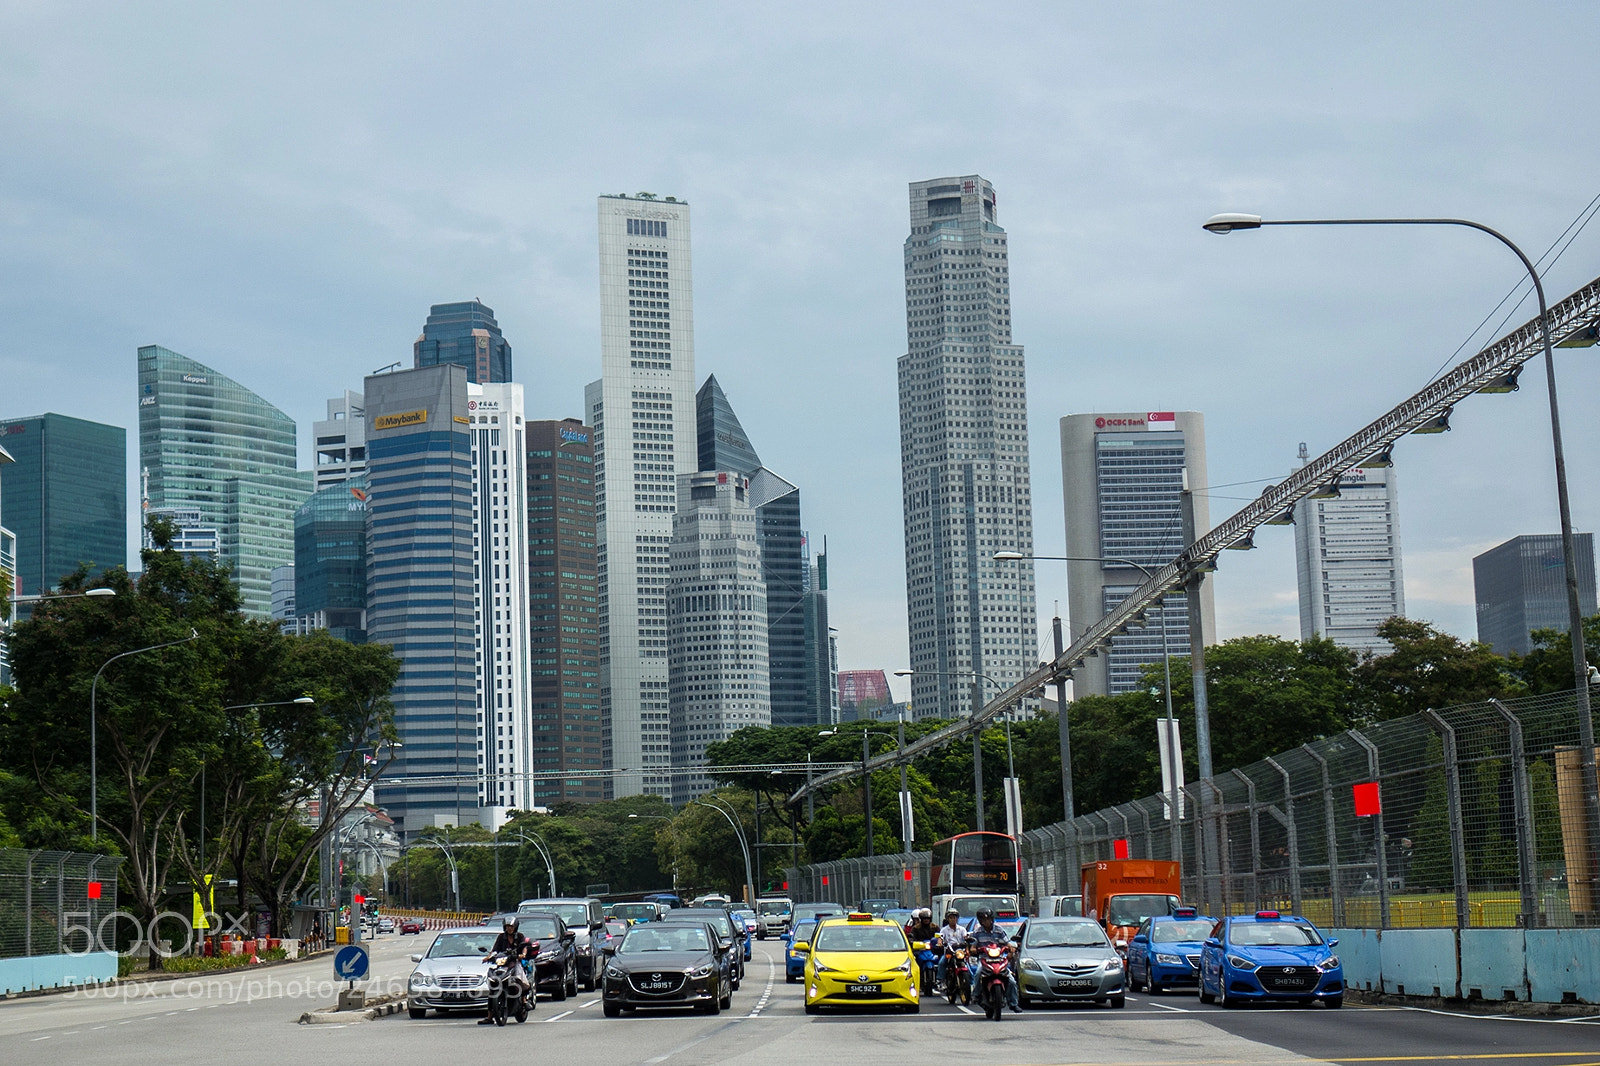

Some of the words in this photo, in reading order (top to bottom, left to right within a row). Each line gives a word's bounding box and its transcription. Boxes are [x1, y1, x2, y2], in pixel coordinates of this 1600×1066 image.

[183, 375, 206, 384] Keppel
[140, 396, 156, 407] ANZ
[385, 412, 421, 426] Maybank
[1128, 418, 1145, 426] Bank
[1341, 473, 1366, 484] Singtel
[999, 872, 1008, 881] 70
